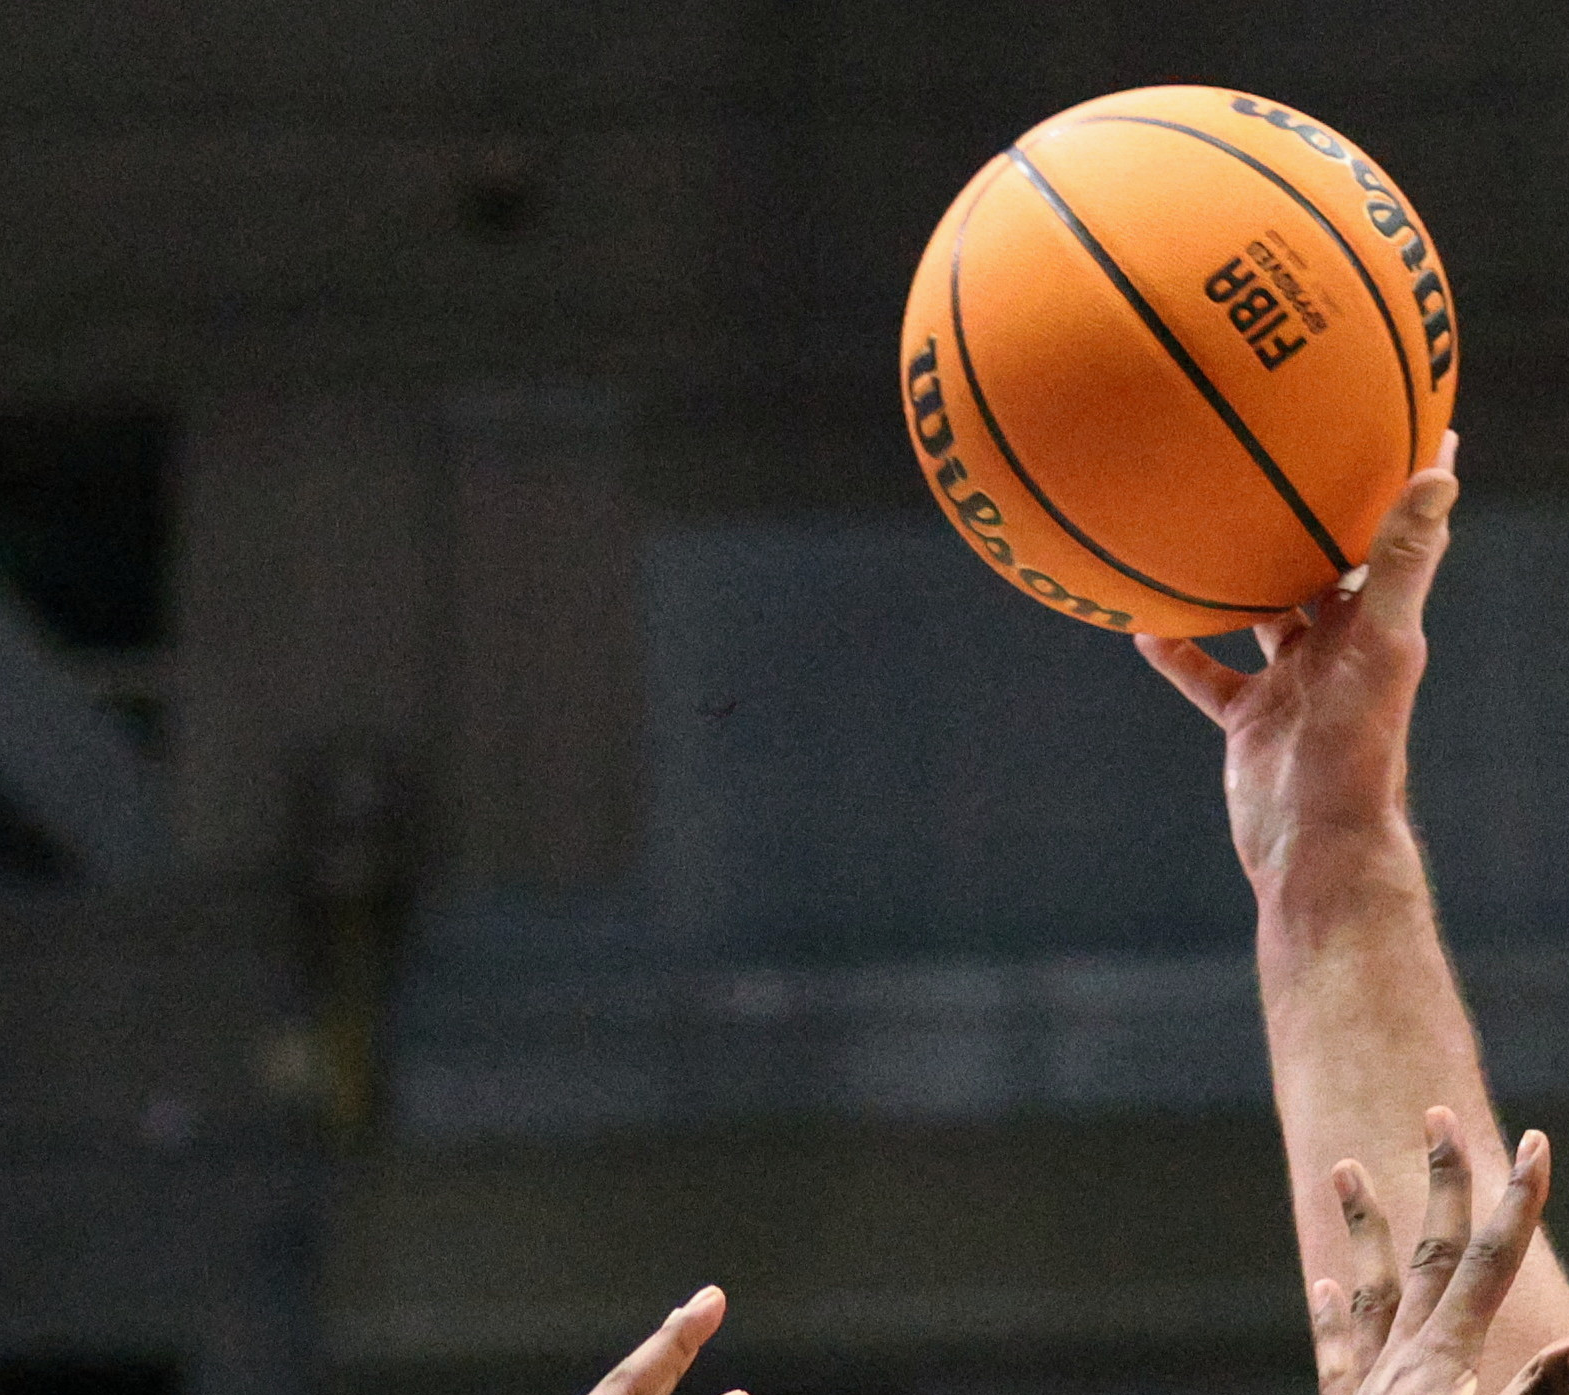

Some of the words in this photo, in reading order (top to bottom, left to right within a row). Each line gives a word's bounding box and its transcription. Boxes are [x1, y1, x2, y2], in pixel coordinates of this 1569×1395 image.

[1204, 257, 1308, 372] FIBA
[1230, 94, 1455, 394] Wilson
[905, 334, 1134, 631] Wilson
